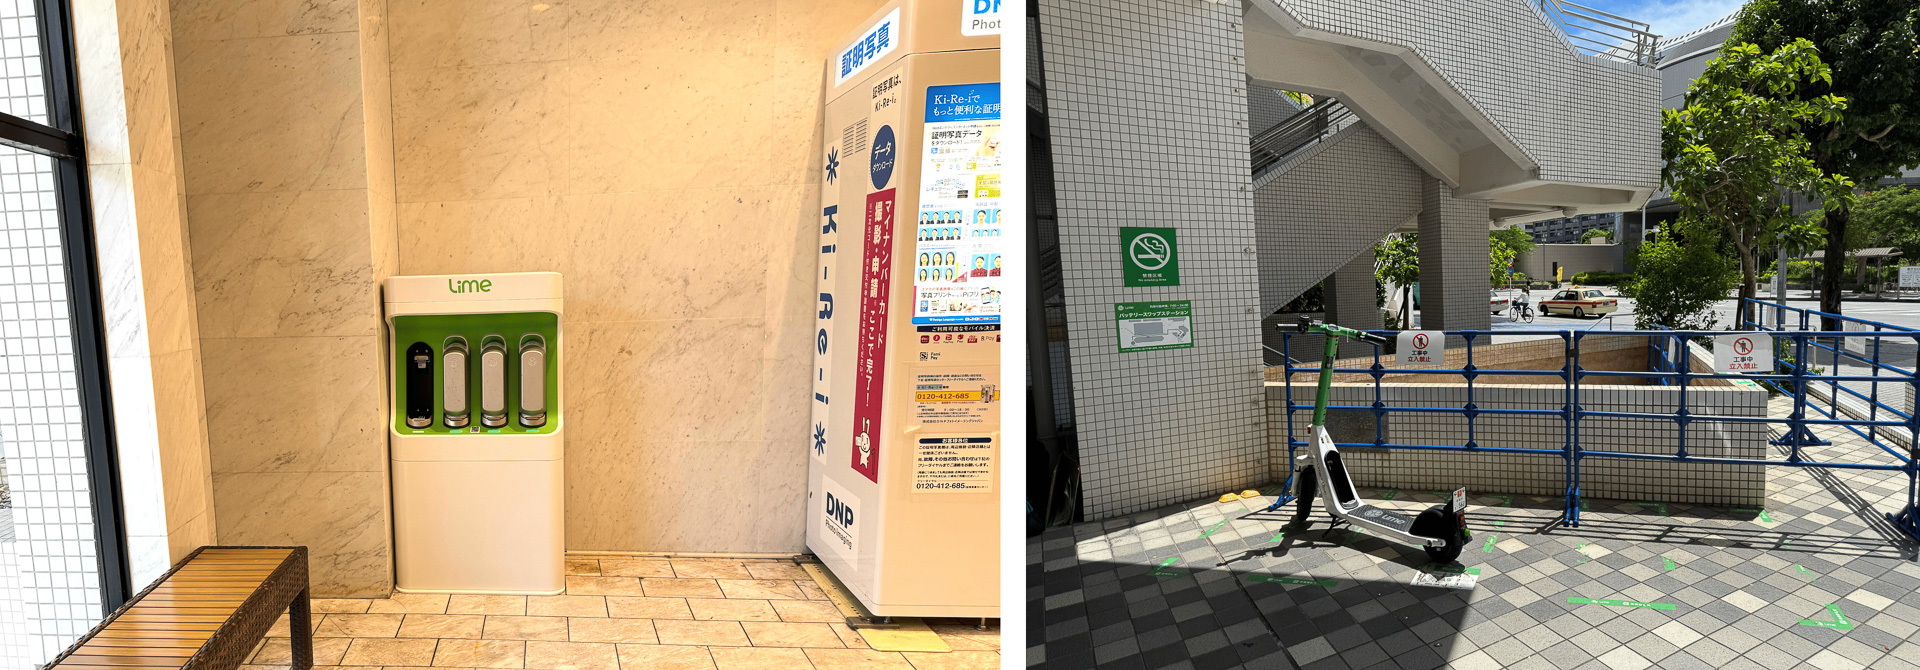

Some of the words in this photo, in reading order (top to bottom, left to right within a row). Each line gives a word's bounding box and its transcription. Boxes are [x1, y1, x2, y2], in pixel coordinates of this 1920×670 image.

[841, 21, 890, 78] 証明写真
[872, 74, 901, 99] 証明写真は、
[933, 91, 980, 105] Ki-Re-iで
[933, 104, 1000, 116] もっと便利な証明
[931, 129, 982, 140] 証明写真データ
[875, 141, 891, 159] データ
[872, 158, 893, 174] ダウンロード
[877, 200, 892, 348] マイナンバーカード
[448, 278, 492, 294] Lime
[815, 204, 838, 404] Ki-Re-i
[1119, 310, 1189, 318] バッテリースワップステーション
[826, 491, 853, 529] DNP
[825, 518, 836, 535] Photo
[835, 527, 853, 550] Imaging
